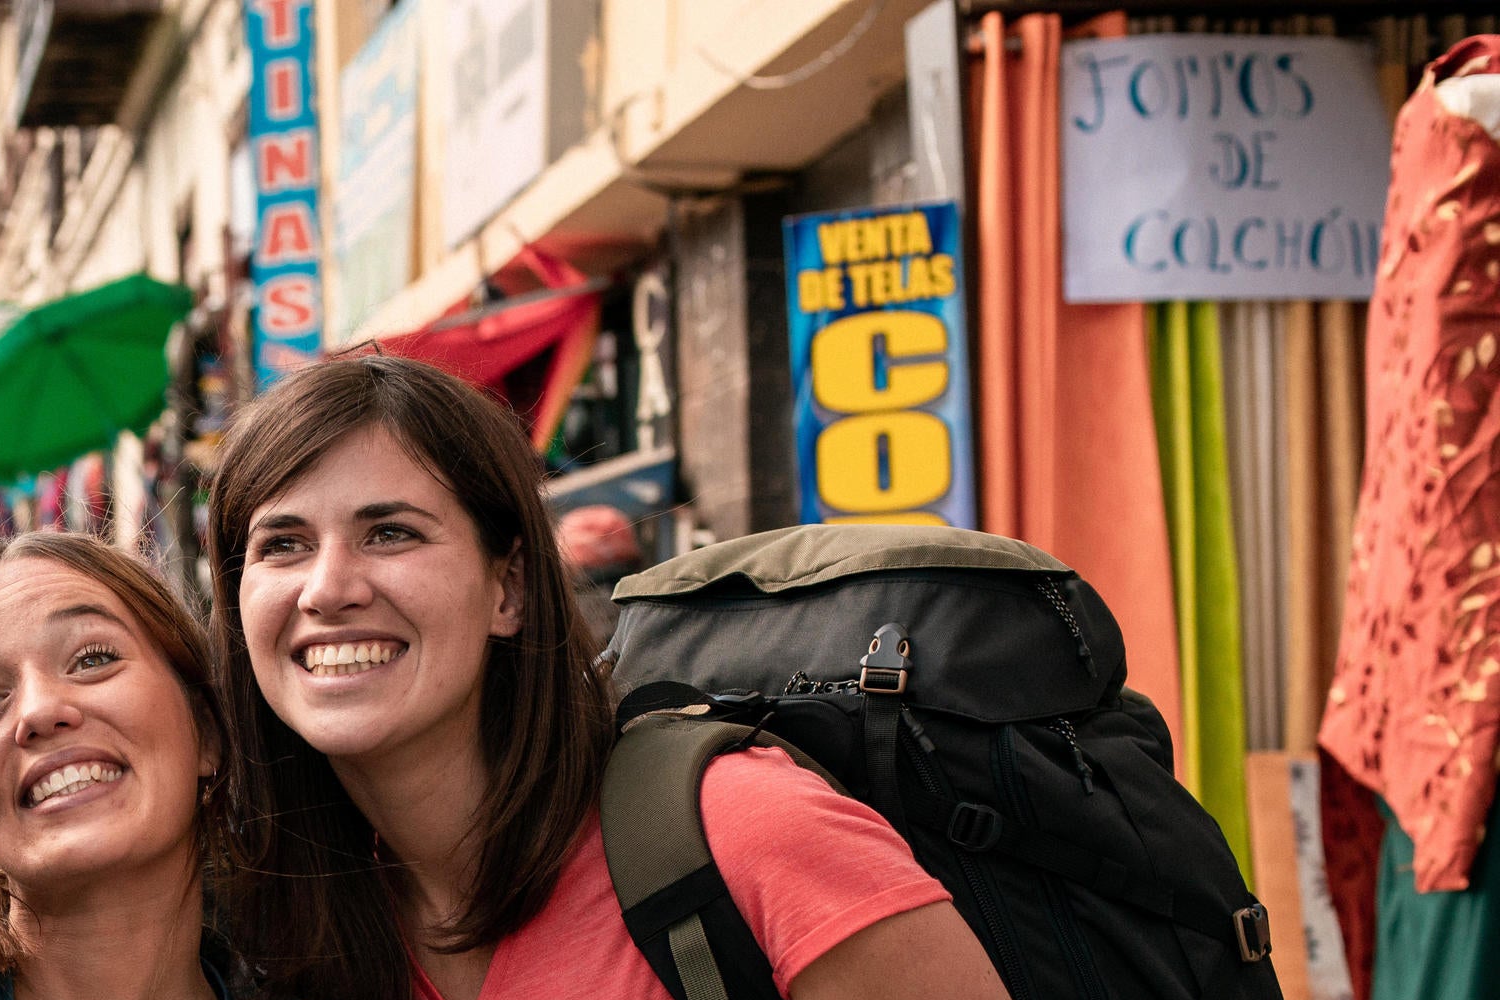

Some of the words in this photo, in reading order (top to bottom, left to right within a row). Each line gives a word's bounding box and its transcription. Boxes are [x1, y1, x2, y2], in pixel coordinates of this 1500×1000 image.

[1208, 128, 1281, 192] DE
[818, 211, 933, 265] VENTA
[798, 267, 846, 313] DE
[848, 254, 957, 308] TELAS
[811, 309, 952, 526] CO
